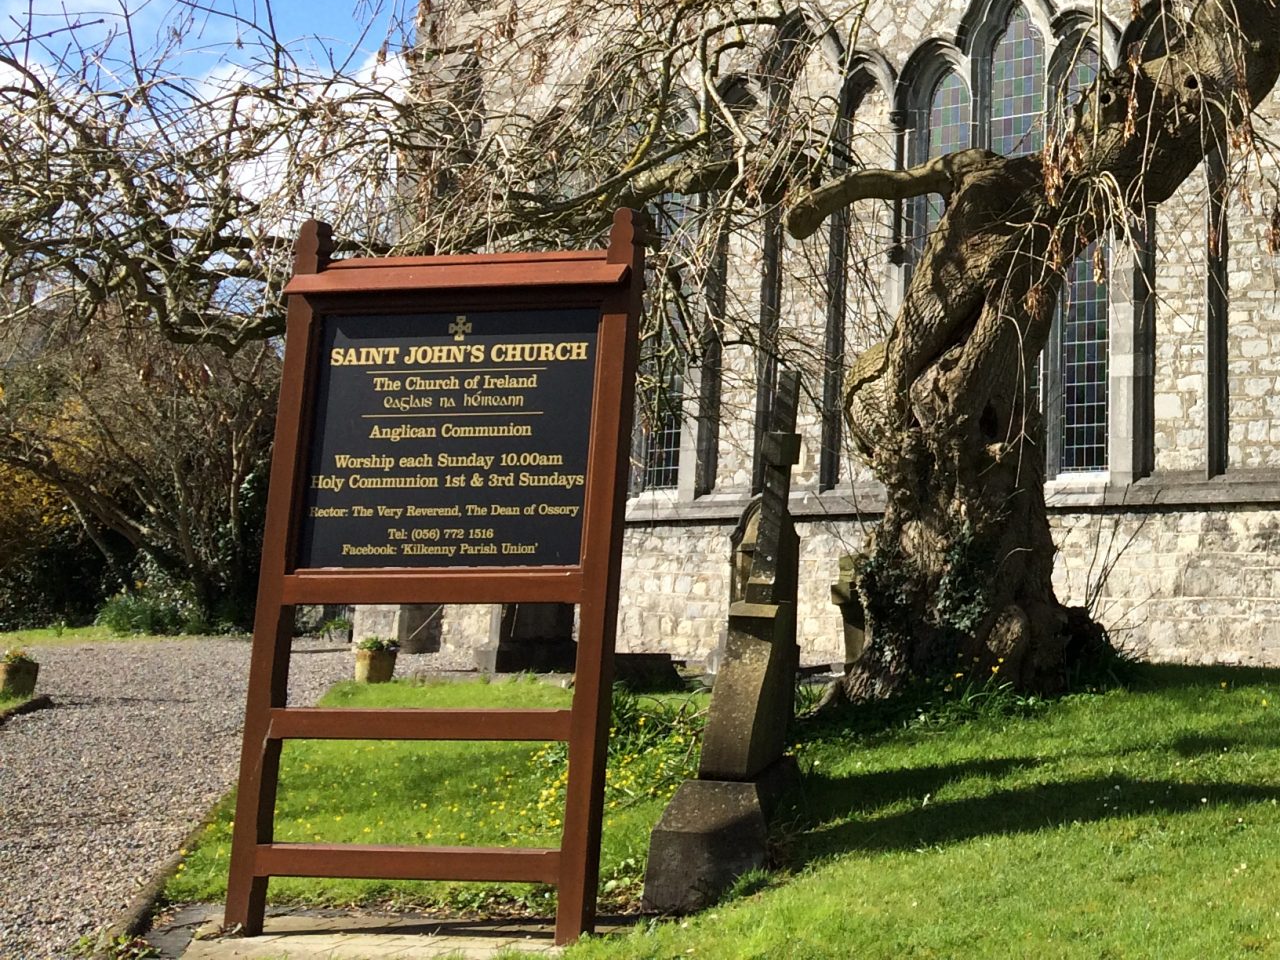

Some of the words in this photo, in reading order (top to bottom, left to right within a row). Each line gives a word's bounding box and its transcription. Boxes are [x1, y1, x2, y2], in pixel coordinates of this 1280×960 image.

[330, 347, 398, 366] SAINT
[404, 345, 484, 364] JOHN'S
[491, 343, 588, 362] CHURCH
[374, 377, 401, 391] The
[405, 376, 460, 390] Church
[465, 375, 480, 389] of
[483, 375, 537, 389] Ireland
[440, 396, 455, 408] na
[369, 424, 436, 441] Anglican
[441, 423, 532, 438] Communion
[335, 455, 394, 470] Worship
[399, 454, 433, 467] each
[438, 454, 494, 469] Sunday
[500, 453, 563, 466] 10.00am
[312, 476, 342, 492] Holy
[349, 475, 438, 489] Communion
[445, 474, 465, 487] 1st
[470, 474, 484, 486] &
[489, 473, 514, 486] 3rd
[519, 472, 584, 489] Sundays
[352, 506, 373, 517] The
[377, 506, 403, 518] Very
[407, 505, 462, 517] Reverend,
[466, 505, 487, 515] The
[490, 505, 520, 515] Dean
[524, 504, 535, 515] of
[538, 504, 579, 517] Ossory
[388, 529, 408, 539] Tel:
[411, 529, 440, 541] (056)
[444, 529, 464, 539] 772
[469, 529, 494, 539] 1516
[342, 544, 397, 555] Facebook:
[460, 543, 497, 553] Parish
